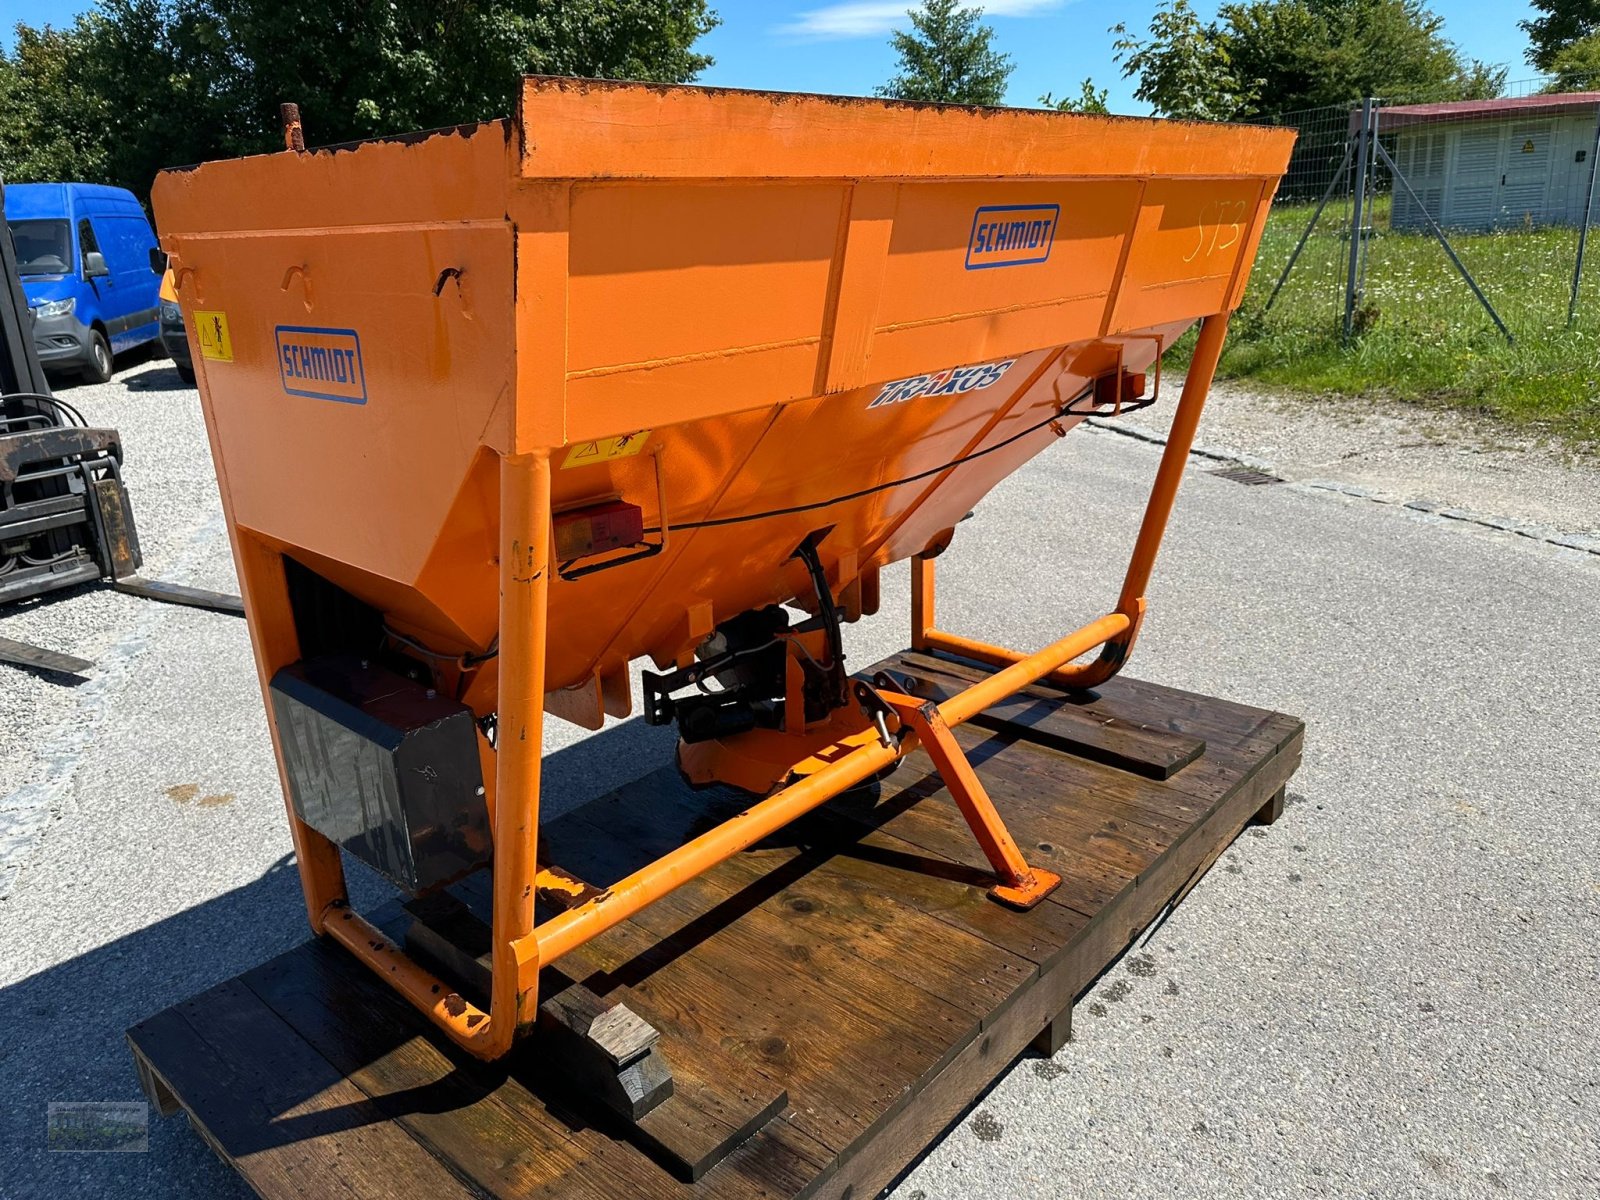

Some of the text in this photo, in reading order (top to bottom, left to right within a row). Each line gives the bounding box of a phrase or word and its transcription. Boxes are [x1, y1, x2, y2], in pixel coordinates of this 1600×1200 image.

[973, 219, 1051, 253] SCHMIDT
[282, 344, 356, 384] SCHMIDT
[866, 359, 1016, 408] TRAXOS
